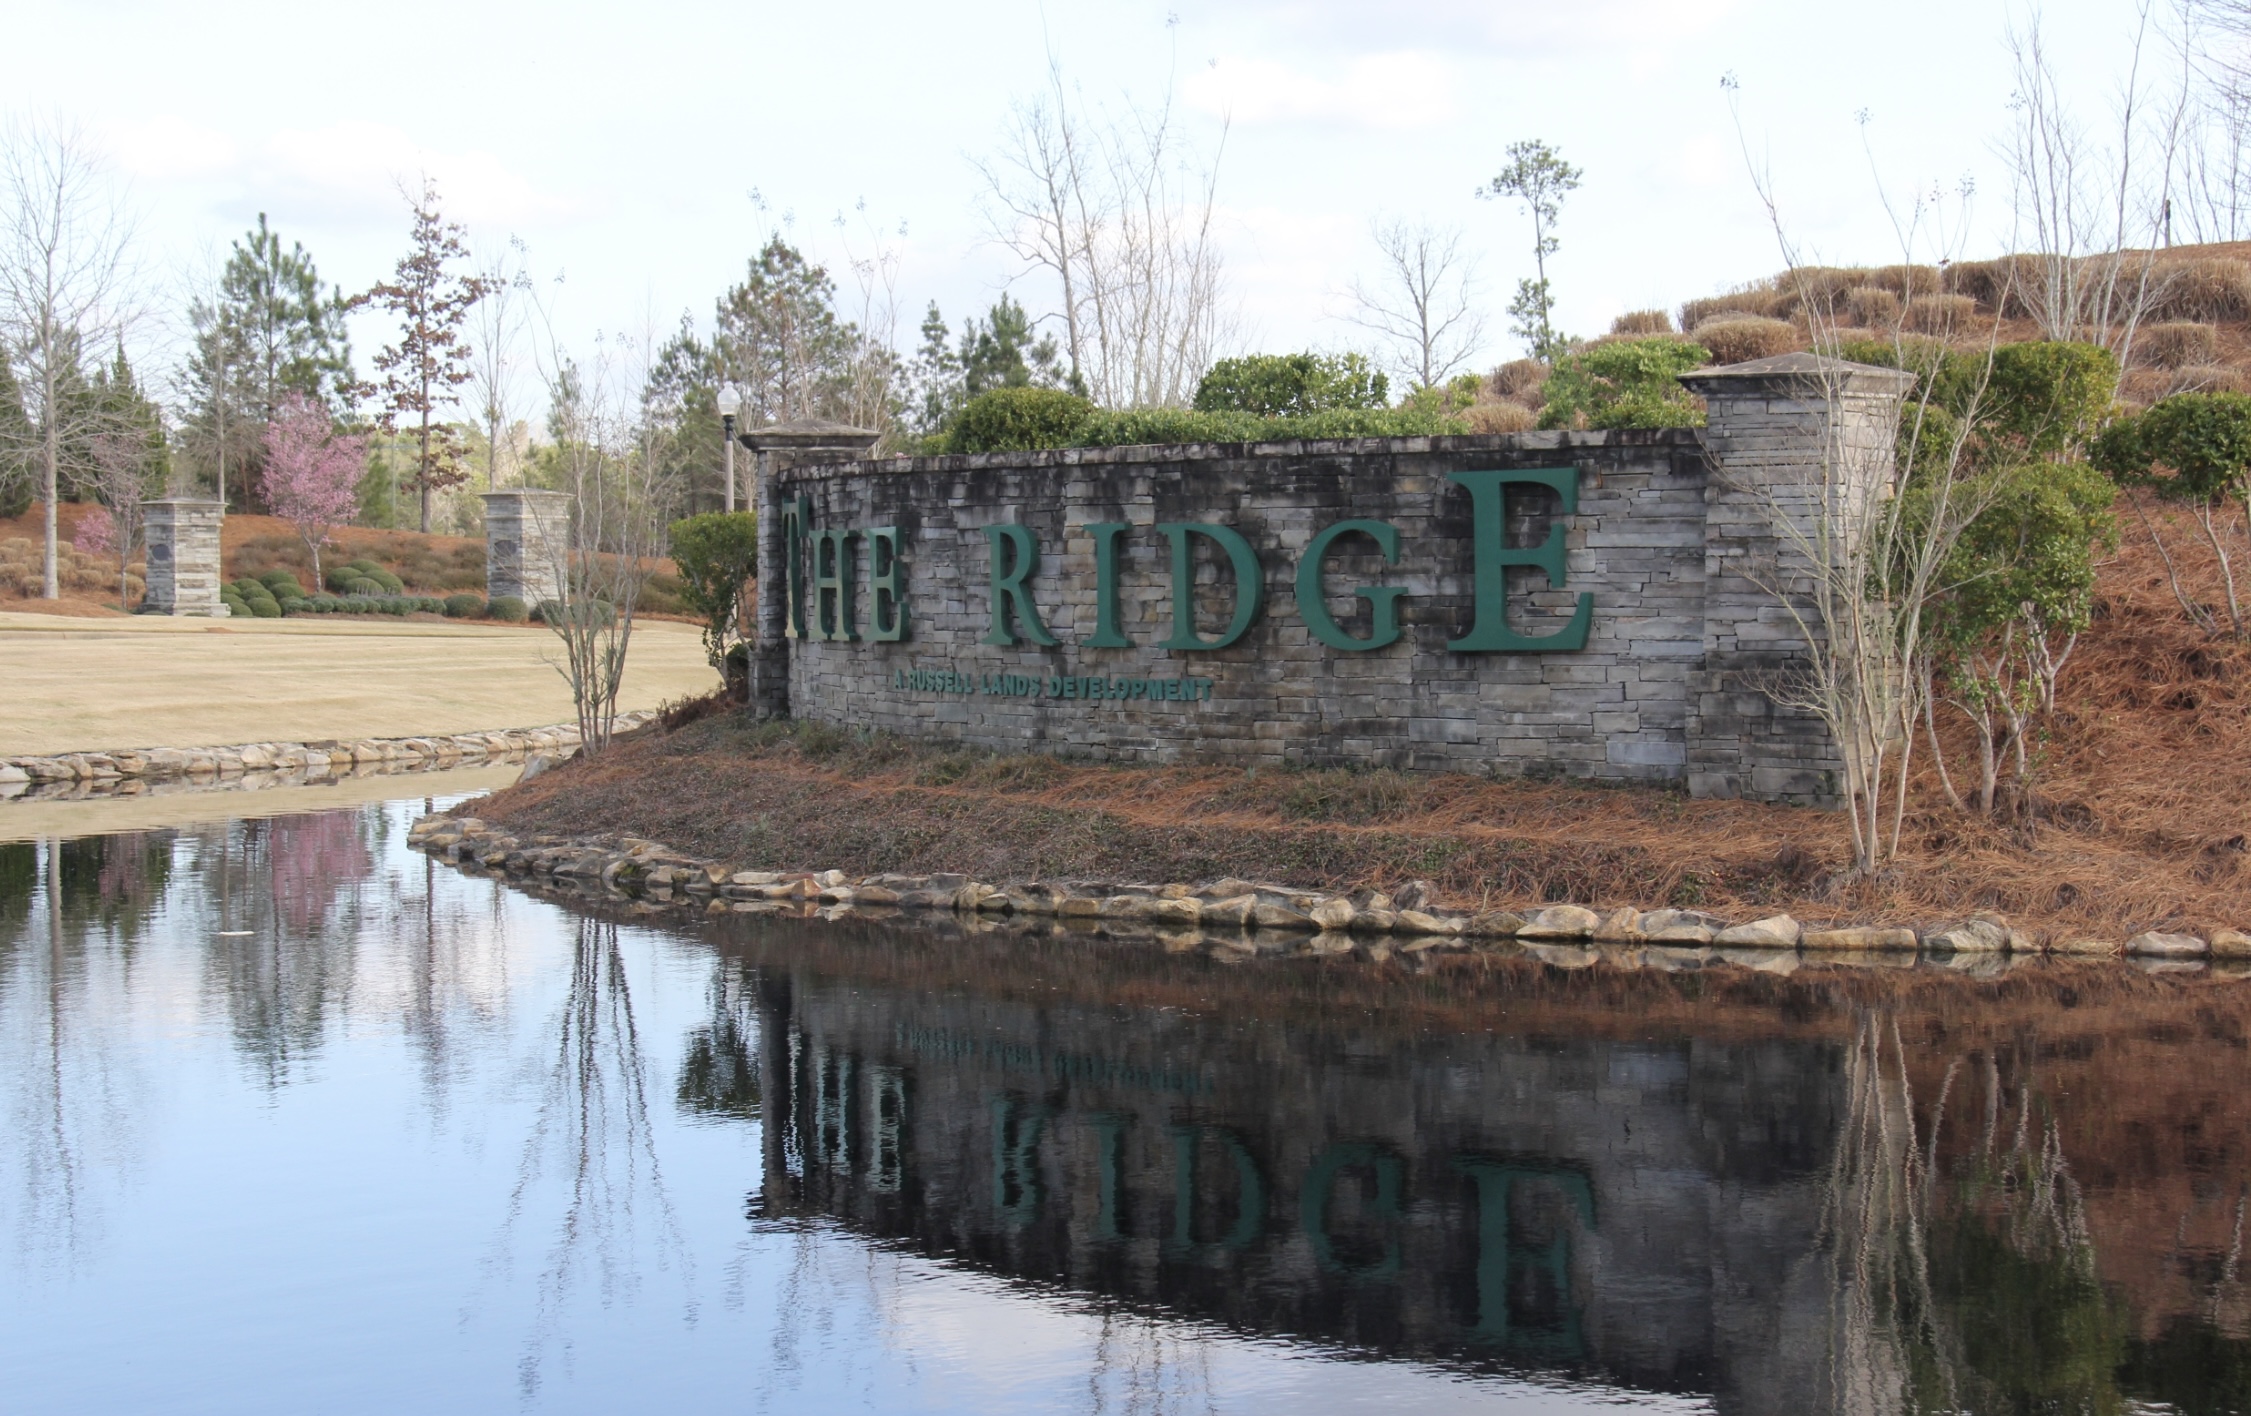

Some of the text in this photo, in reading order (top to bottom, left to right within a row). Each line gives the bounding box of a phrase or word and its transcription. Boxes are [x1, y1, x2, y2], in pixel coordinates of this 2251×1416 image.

[781, 467, 1593, 652] THE RIDGE
[894, 668, 1213, 702] A RUSSELL LANDS DEVELOPMENT
